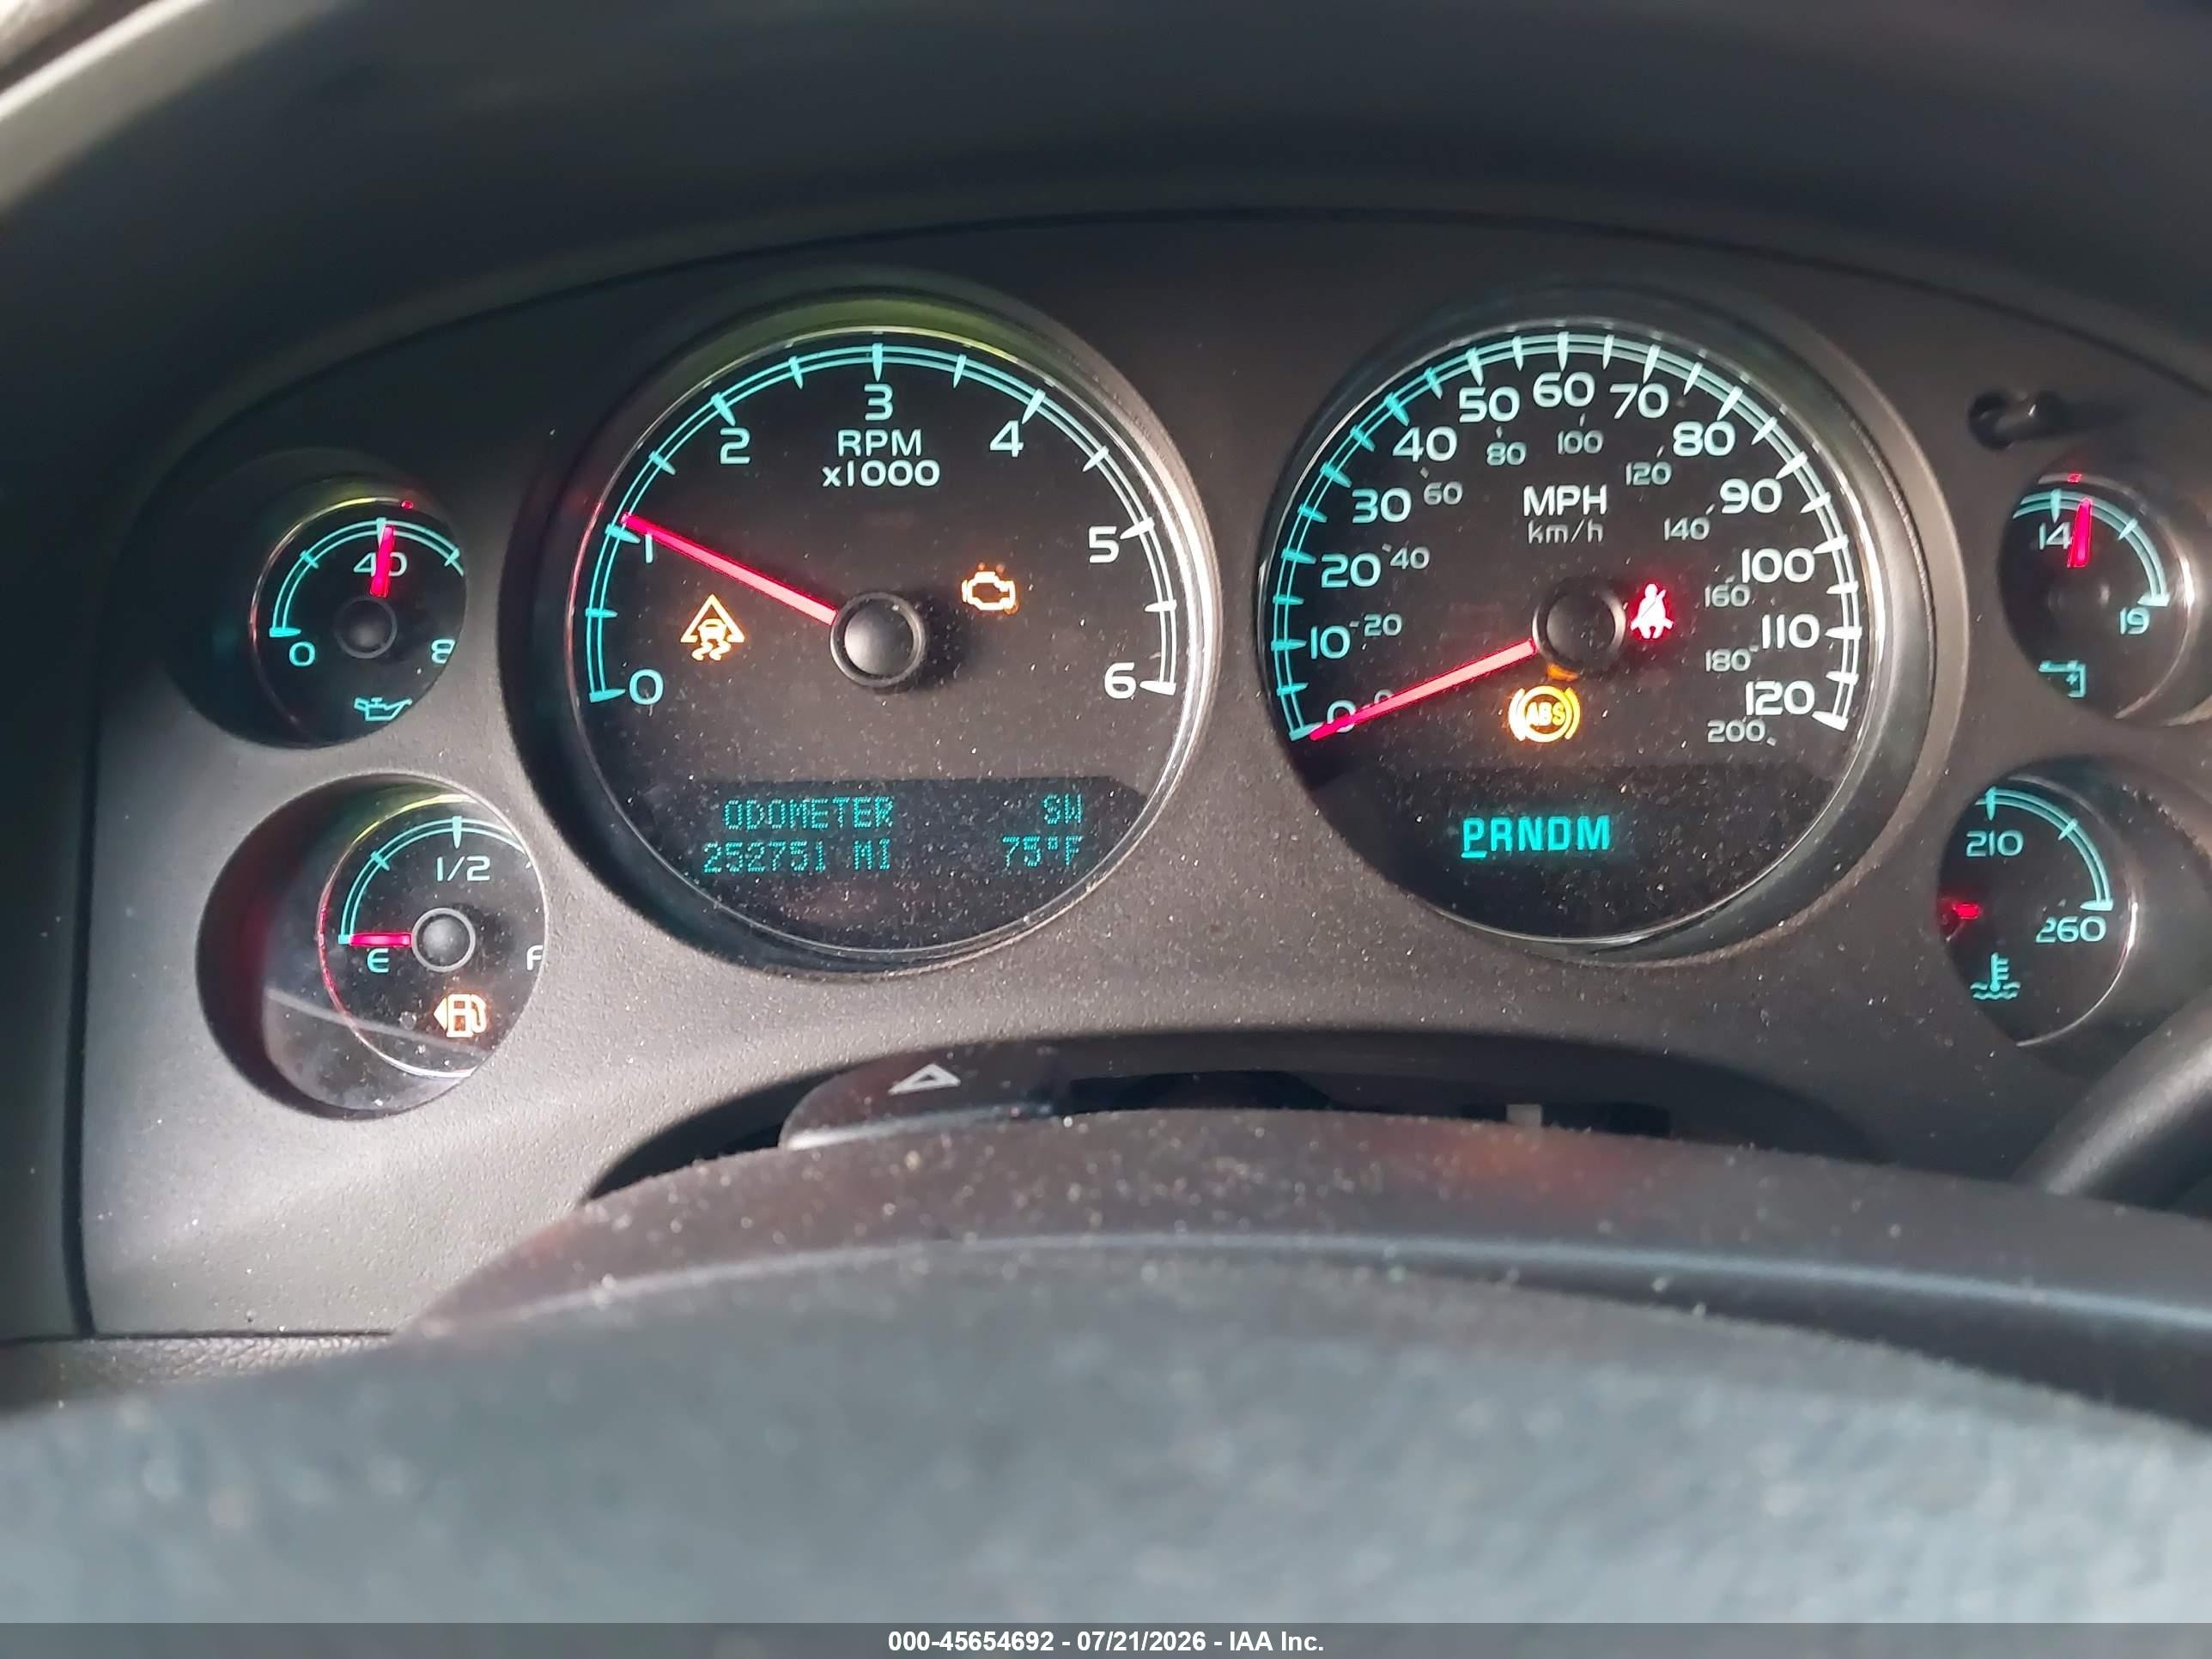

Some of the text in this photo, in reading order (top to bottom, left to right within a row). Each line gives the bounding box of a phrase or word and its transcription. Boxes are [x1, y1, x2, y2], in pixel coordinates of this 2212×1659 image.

[864, 384, 894, 421] 3
[1459, 386, 1521, 422] 50
[1533, 371, 1595, 407] 60
[1610, 383, 1669, 419] 70
[720, 427, 751, 465] 2
[837, 429, 922, 457] RPM
[989, 420, 1024, 458] 4
[1392, 426, 1458, 463] 40
[1486, 441, 1527, 466] 80
[1557, 430, 1604, 454] 100
[1673, 421, 1735, 456] 80
[822, 460, 940, 487] x1000
[1626, 461, 1673, 486] 120
[1351, 487, 1413, 525] 30
[1423, 481, 1463, 505] 60
[1522, 483, 1607, 517] MPH
[1719, 477, 1784, 514] 90
[1088, 526, 1120, 563] 5
[1528, 519, 1604, 544] km/h
[1663, 516, 1711, 541] 140
[2038, 521, 2070, 550] 14
[645, 532, 653, 563] 1
[1389, 546, 1431, 570] 40
[1321, 552, 1382, 588] 20
[1741, 548, 1816, 584] 100
[1704, 583, 1751, 608] 160
[1364, 613, 1402, 637] 20
[1761, 613, 1820, 649] 110
[2118, 606, 2151, 635] 19
[289, 641, 316, 667] 0
[1310, 625, 1351, 659] 10
[1705, 647, 1752, 672] 180
[629, 669, 665, 706] 0
[1104, 661, 1137, 699] 6
[1524, 700, 1566, 726] ABS
[1745, 680, 1815, 715] 120
[1707, 719, 1765, 743] 200
[724, 796, 894, 830] ODOMETER
[1042, 793, 1085, 826] SW
[1462, 815, 1611, 852] PRNDM
[1966, 830, 2024, 858] 210
[436, 856, 490, 882] 1/2
[702, 837, 891, 874] 252751 MI
[2035, 915, 2106, 944] 260
[367, 947, 390, 974] E
